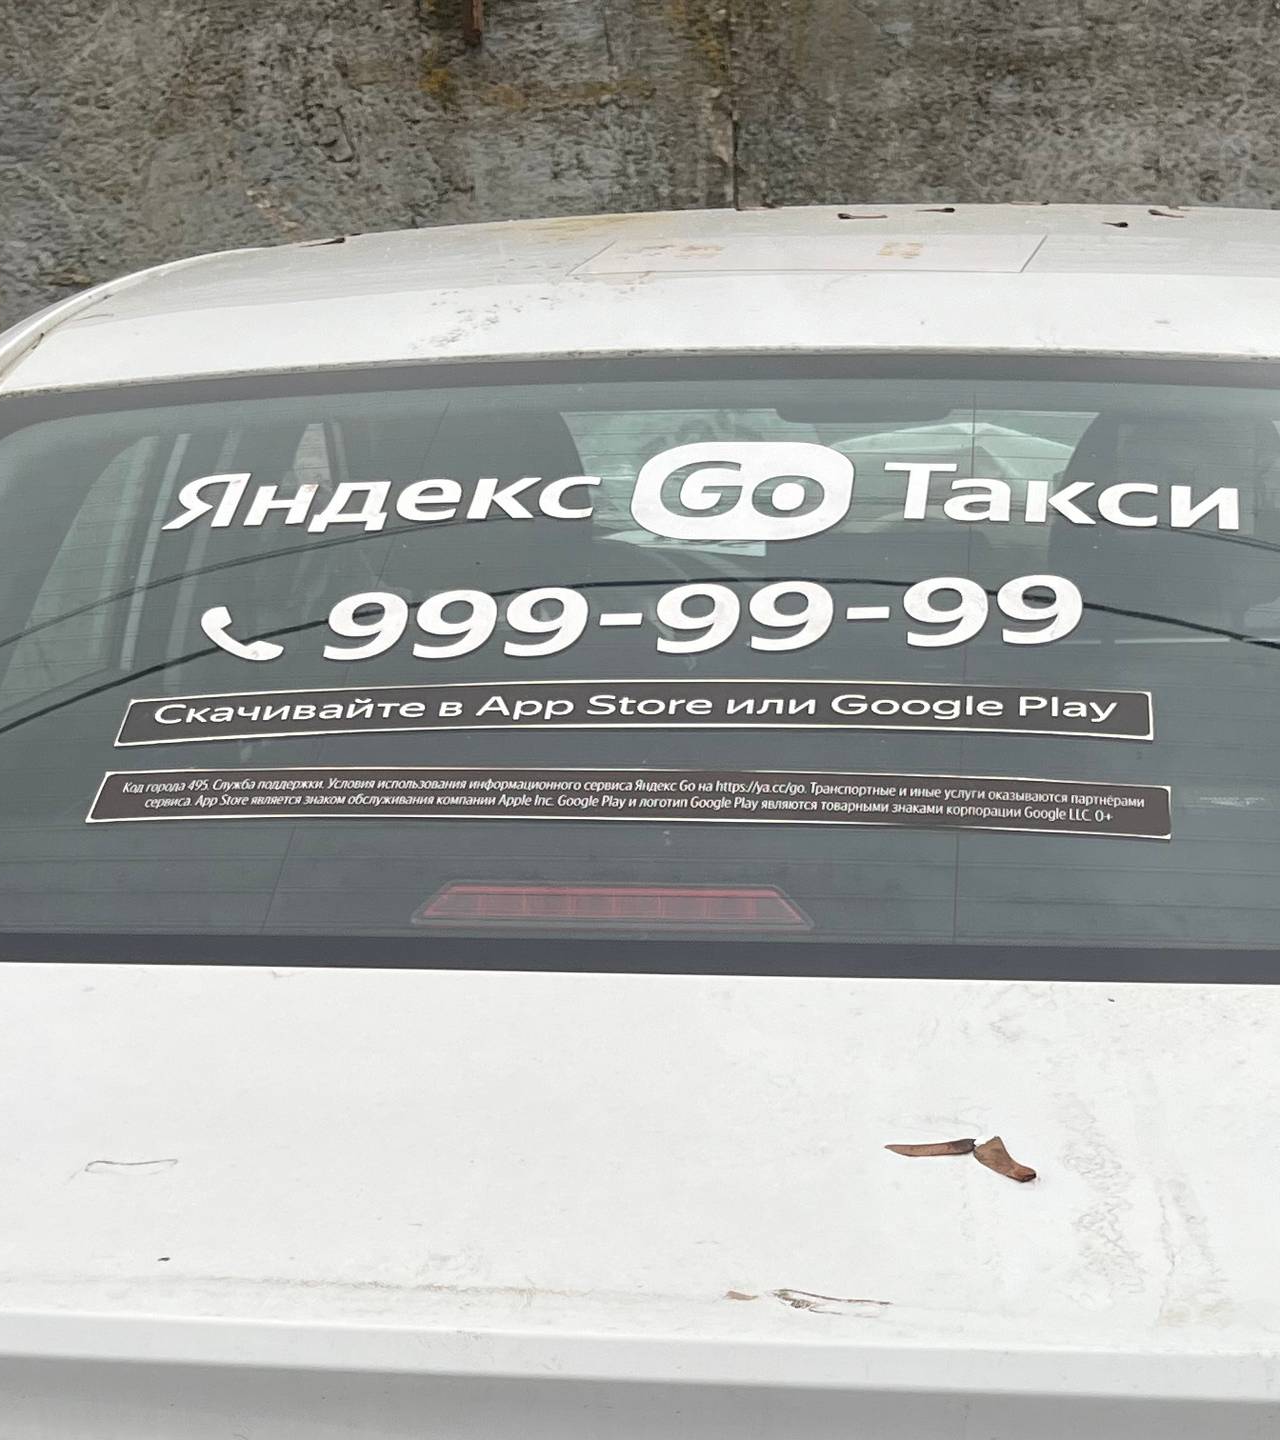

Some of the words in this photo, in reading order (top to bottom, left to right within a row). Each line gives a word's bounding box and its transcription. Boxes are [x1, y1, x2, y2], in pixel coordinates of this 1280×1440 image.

[162, 471, 602, 532] Яндекс
[884, 462, 1240, 530] Такси
[322, 574, 1083, 661] 999-99-99
[154, 698, 426, 724] Скачивайте
[438, 701, 463, 717] в
[476, 695, 574, 720] App
[586, 694, 713, 715] Store
[726, 698, 816, 715] или
[831, 694, 1004, 720] Google
[1019, 695, 1118, 722] Play
[123, 781, 144, 794] Код
[145, 782, 187, 794] города
[212, 778, 256, 793] Служба
[327, 777, 375, 790] Условия
[377, 779, 467, 790] использования
[469, 778, 582, 792] информационного
[584, 781, 633, 792] сервиса
[634, 778, 678, 793] Яндекс
[679, 779, 697, 792] Go
[698, 782, 714, 792] на
[810, 781, 897, 798] Транспортные
[899, 787, 908, 797] и
[910, 787, 942, 798] иные
[944, 789, 986, 802] услуги
[988, 790, 1068, 803] оказываются
[195, 794, 219, 808] App
[220, 793, 250, 806] Store
[251, 795, 302, 805] является
[303, 795, 346, 805] знаком
[347, 792, 434, 807] обслуживания
[436, 795, 496, 806] компании
[498, 793, 533, 808] Apple
[557, 794, 599, 809] Google
[601, 794, 627, 810] Play
[628, 798, 637, 808] и
[639, 797, 688, 808] логотип
[690, 795, 732, 811] Google
[734, 796, 760, 812] Play
[761, 799, 818, 811] являются
[821, 800, 890, 814] товарными
[892, 803, 944, 815] знаками
[946, 805, 1022, 818] корпорации
[1024, 805, 1067, 822] Google
[1095, 809, 1115, 823] 0+
